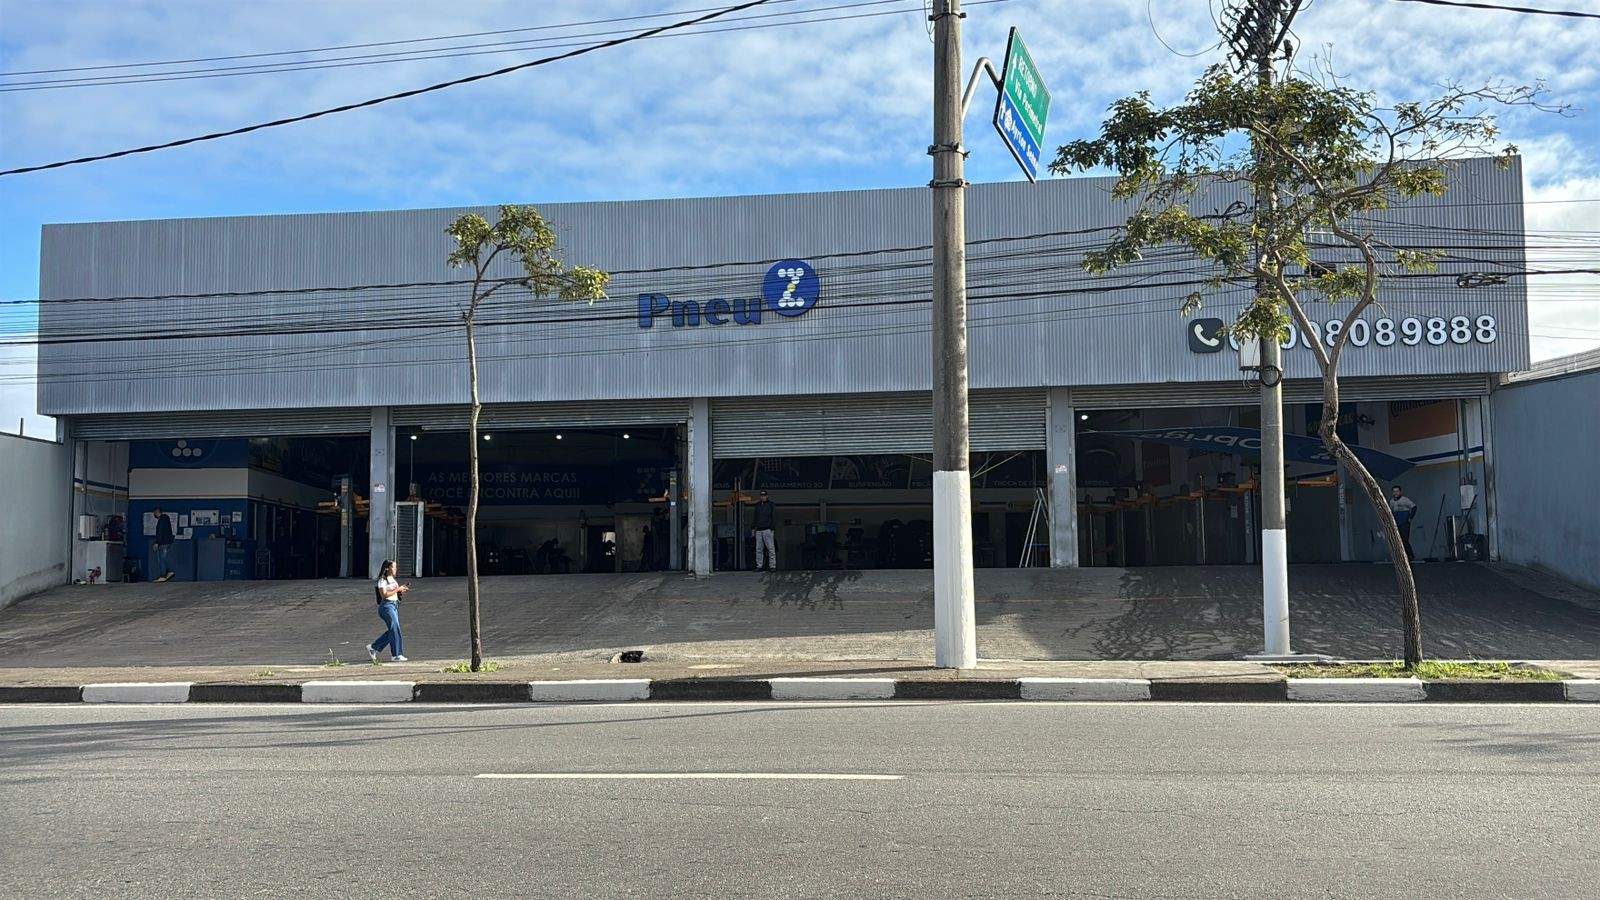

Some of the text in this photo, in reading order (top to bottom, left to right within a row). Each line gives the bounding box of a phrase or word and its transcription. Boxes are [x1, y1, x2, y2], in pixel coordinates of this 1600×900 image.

[638, 292, 762, 328] Pneu
[428, 472, 577, 483] AS MEORES MARCAS
